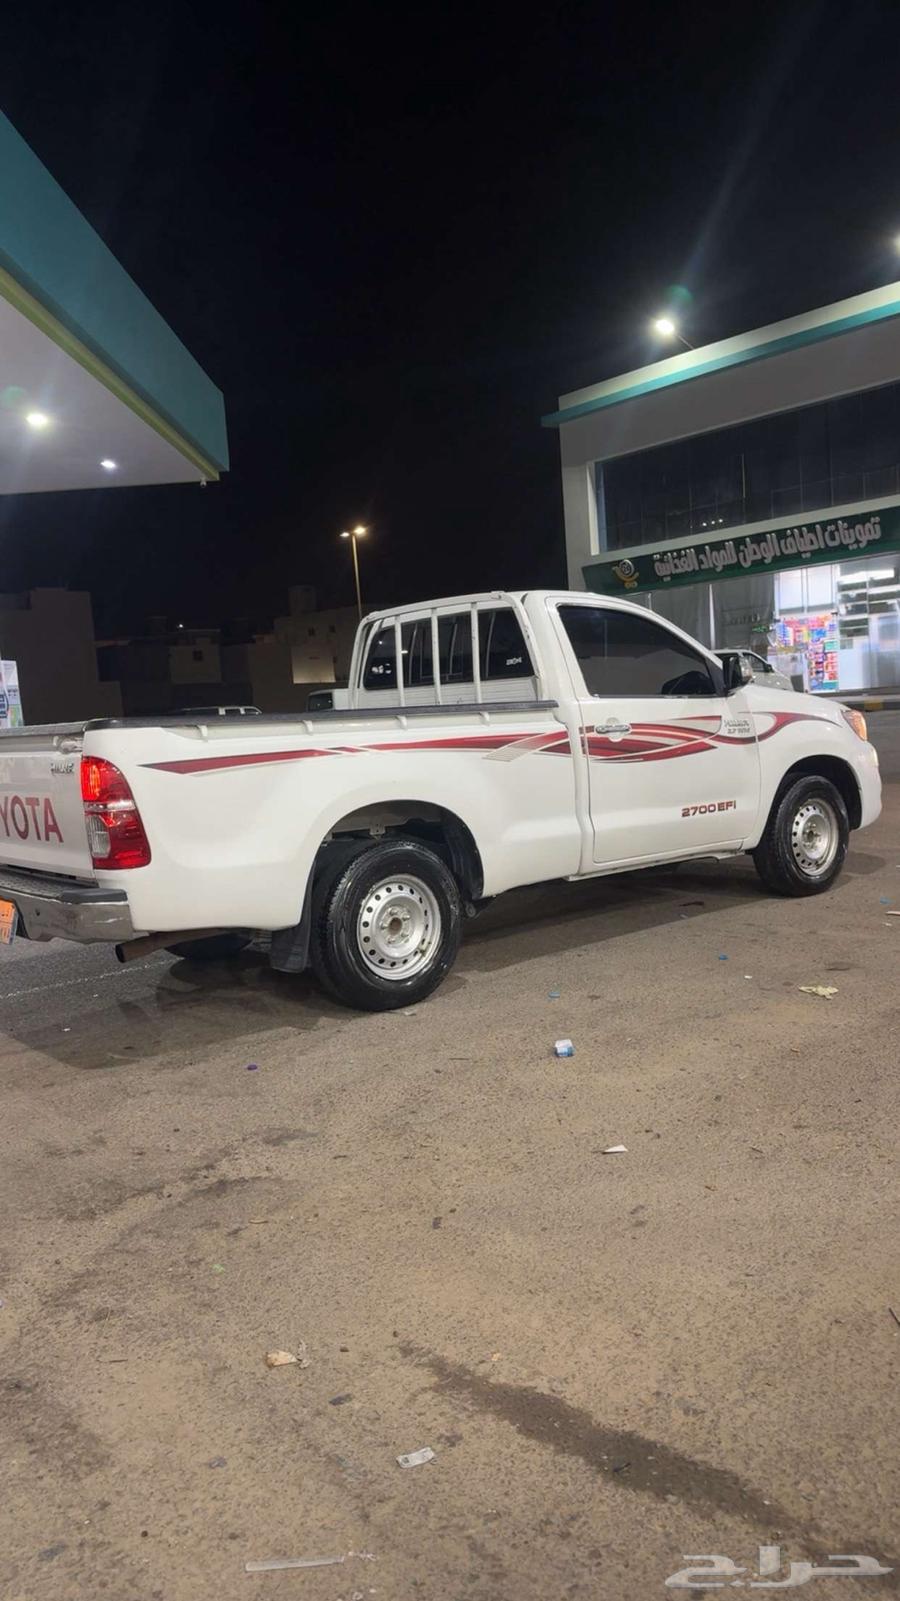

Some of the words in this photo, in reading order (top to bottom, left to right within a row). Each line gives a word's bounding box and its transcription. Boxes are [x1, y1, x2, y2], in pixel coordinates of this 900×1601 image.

[824, 516, 882, 550] تموينات
[699, 541, 738, 572] للمواد
[738, 533, 781, 569] الوطن
